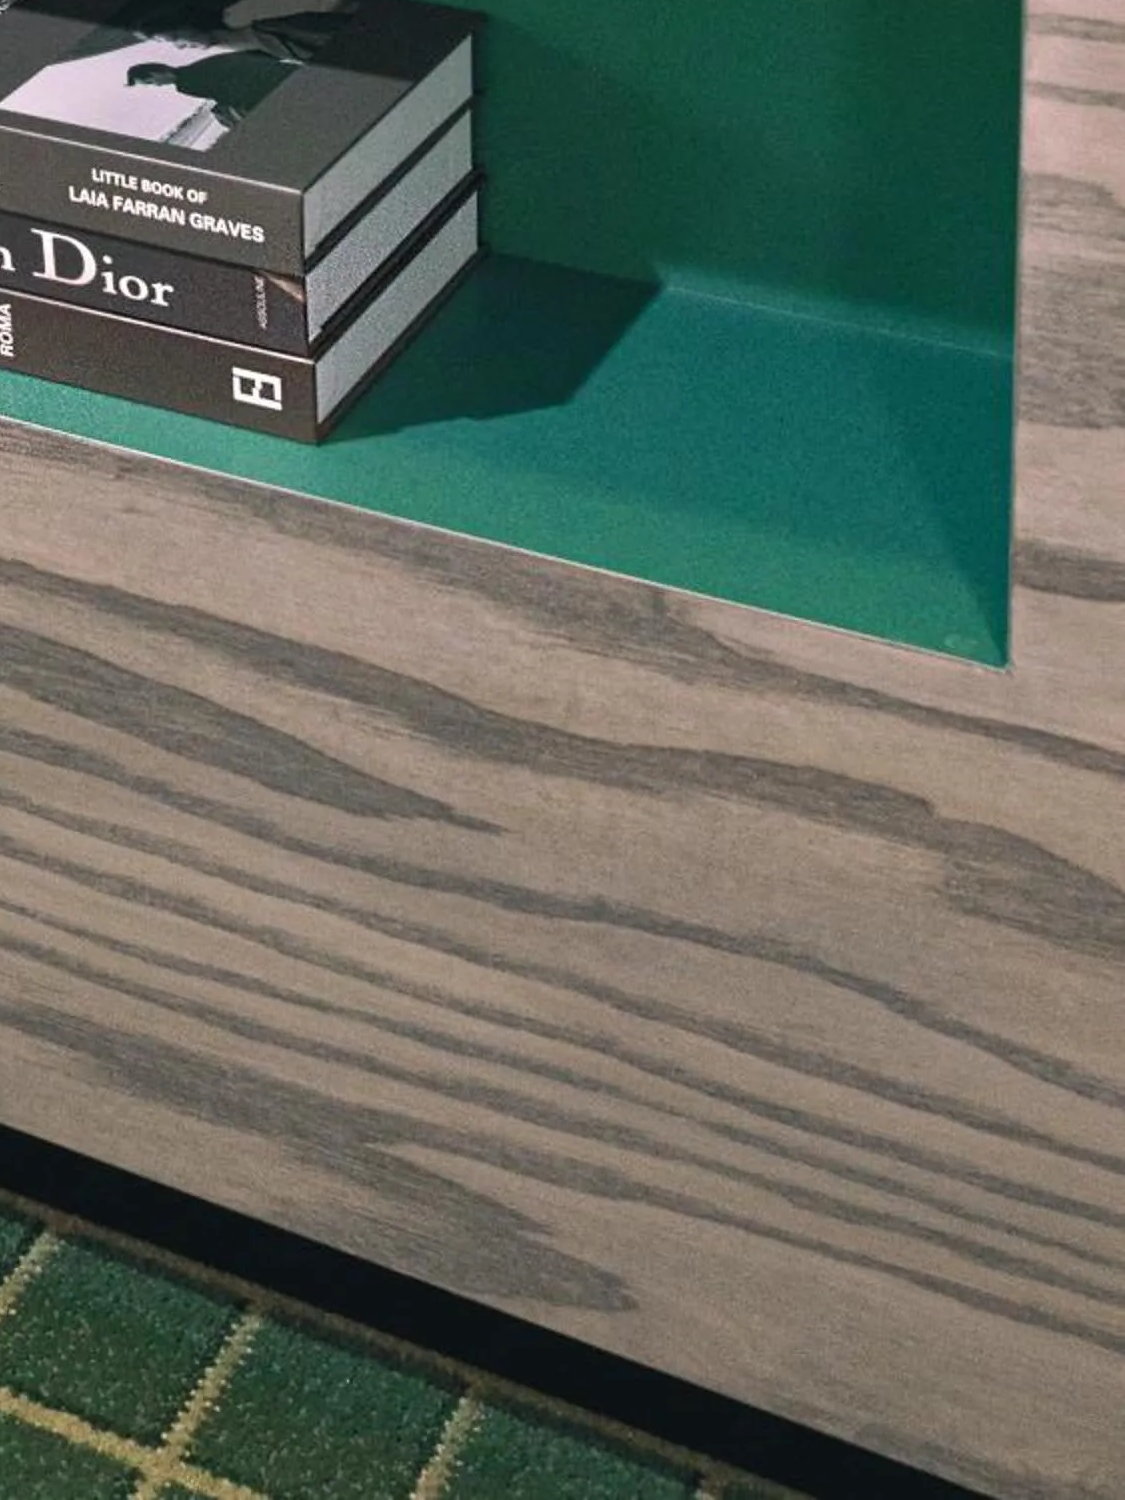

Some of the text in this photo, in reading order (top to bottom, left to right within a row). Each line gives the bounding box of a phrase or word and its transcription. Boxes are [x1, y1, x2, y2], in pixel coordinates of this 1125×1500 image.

[69, 185, 266, 244] LAIA FARRAN GRAVES
[91, 168, 209, 205] LITTLE BOOK OF
[31, 227, 174, 308] Dior
